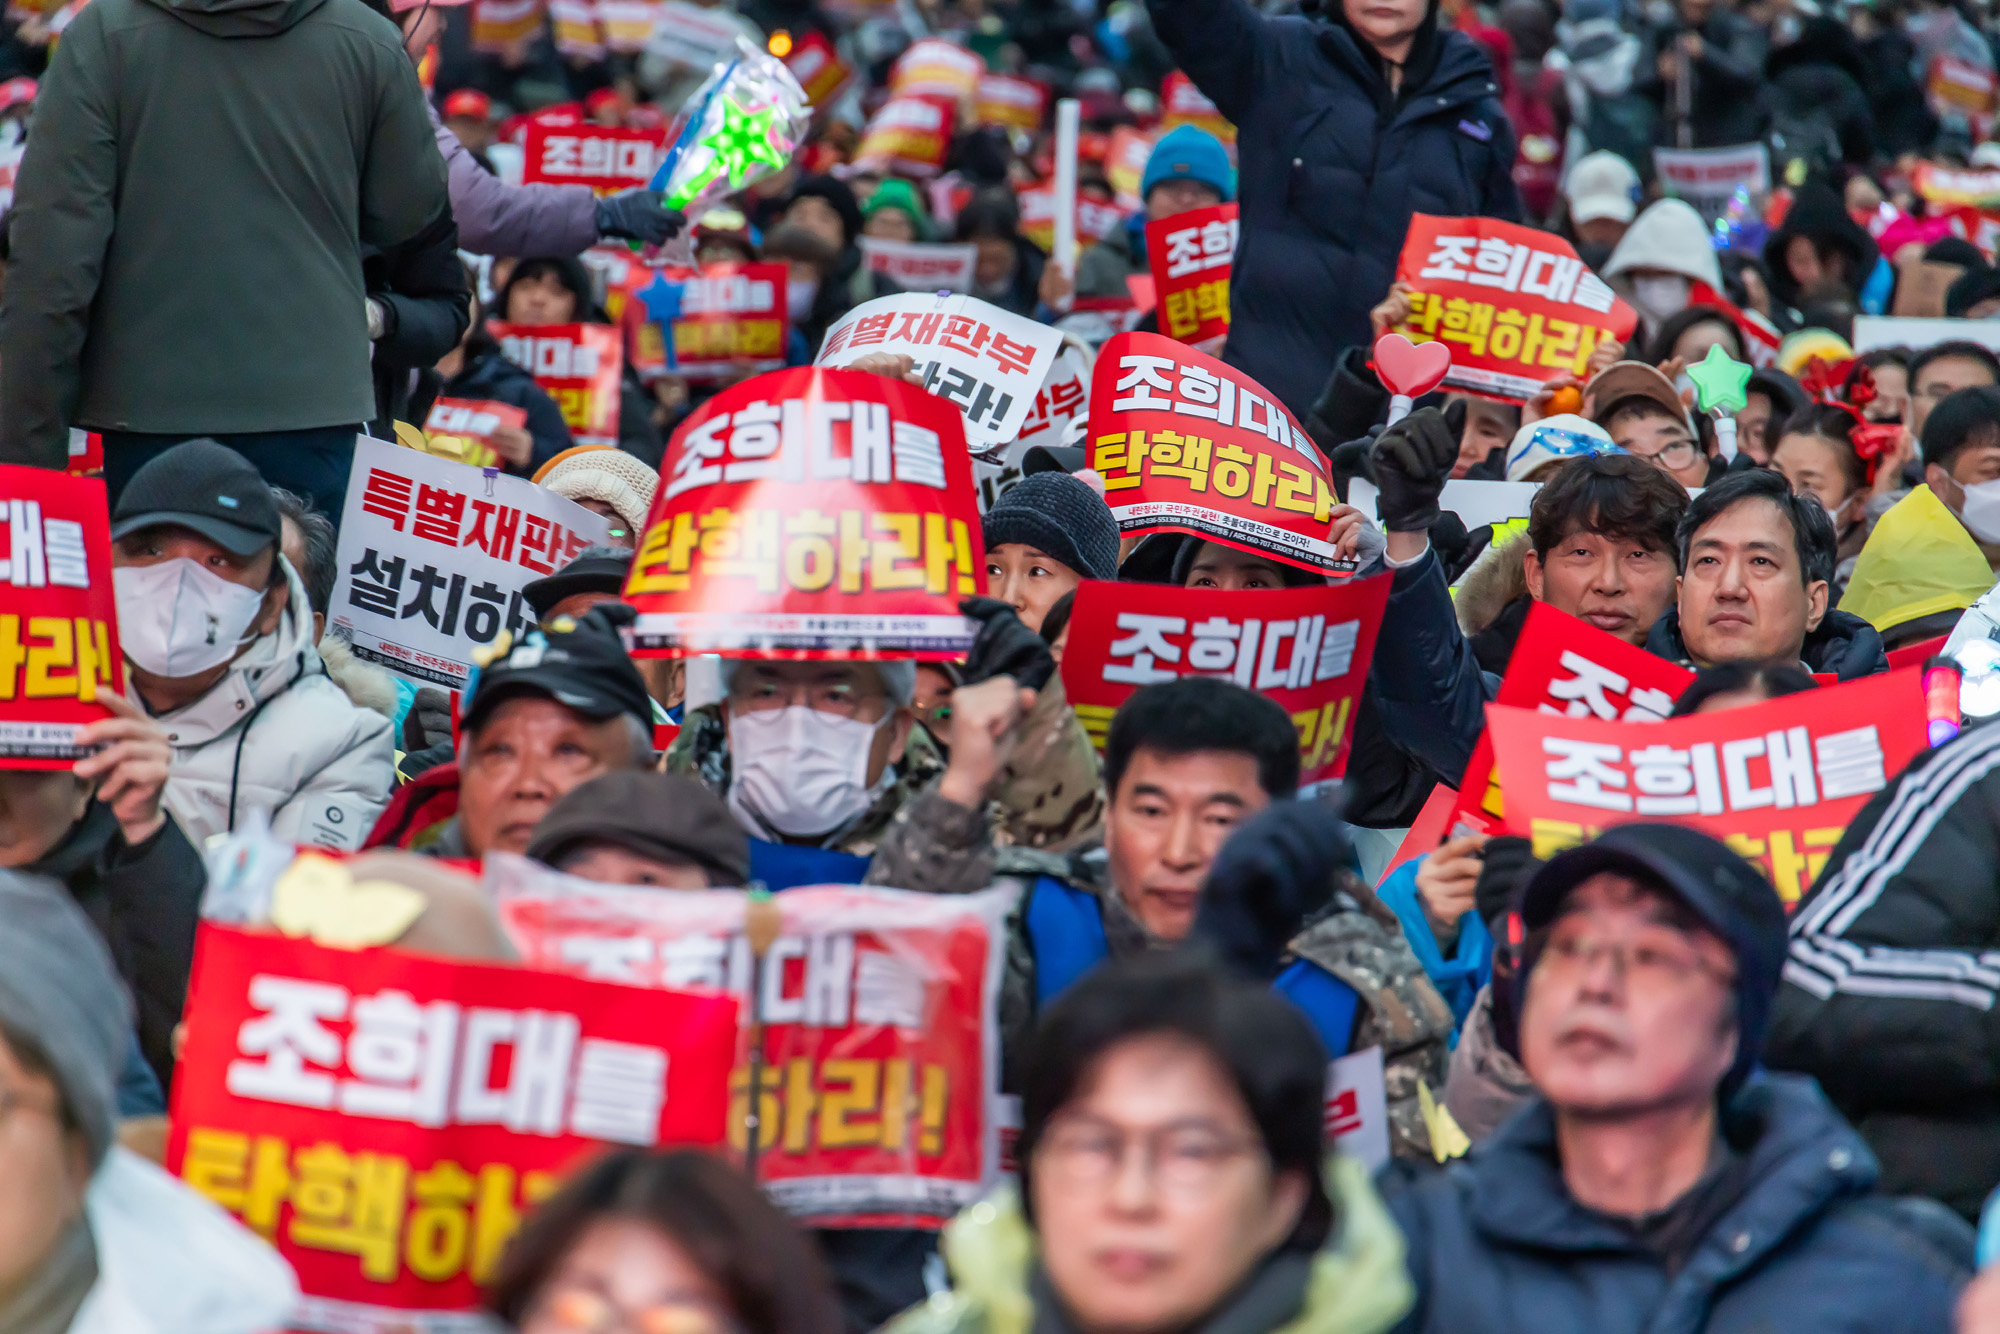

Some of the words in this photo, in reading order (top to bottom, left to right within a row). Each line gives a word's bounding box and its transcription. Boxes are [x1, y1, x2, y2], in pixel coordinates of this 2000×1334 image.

[541, 135, 668, 180] 조희대
[681, 275, 773, 312] 희대를
[1165, 219, 1239, 279] 조희
[1420, 235, 1616, 314] 조희대를
[501, 334, 599, 378] 희대를
[818, 312, 1037, 375] 특별재판부
[665, 399, 947, 499] 조희대를
[1113, 355, 1325, 475] 조희대를
[1094, 430, 1338, 523] 탄핵하라
[624, 506, 976, 596] 탄핵하라!
[1128, 504, 1163, 516] 내란청산!
[1166, 504, 1220, 522] 국민주권실현!
[1282, 532, 1311, 548] 모이자!
[349, 548, 538, 643] 설치하
[1102, 612, 1360, 690] 조희대를
[1541, 725, 1887, 815] 조희대를
[225, 973, 669, 1147] 조희대를
[727, 1056, 948, 1157] 하라!
[180, 1125, 556, 1285] 탄핵하
